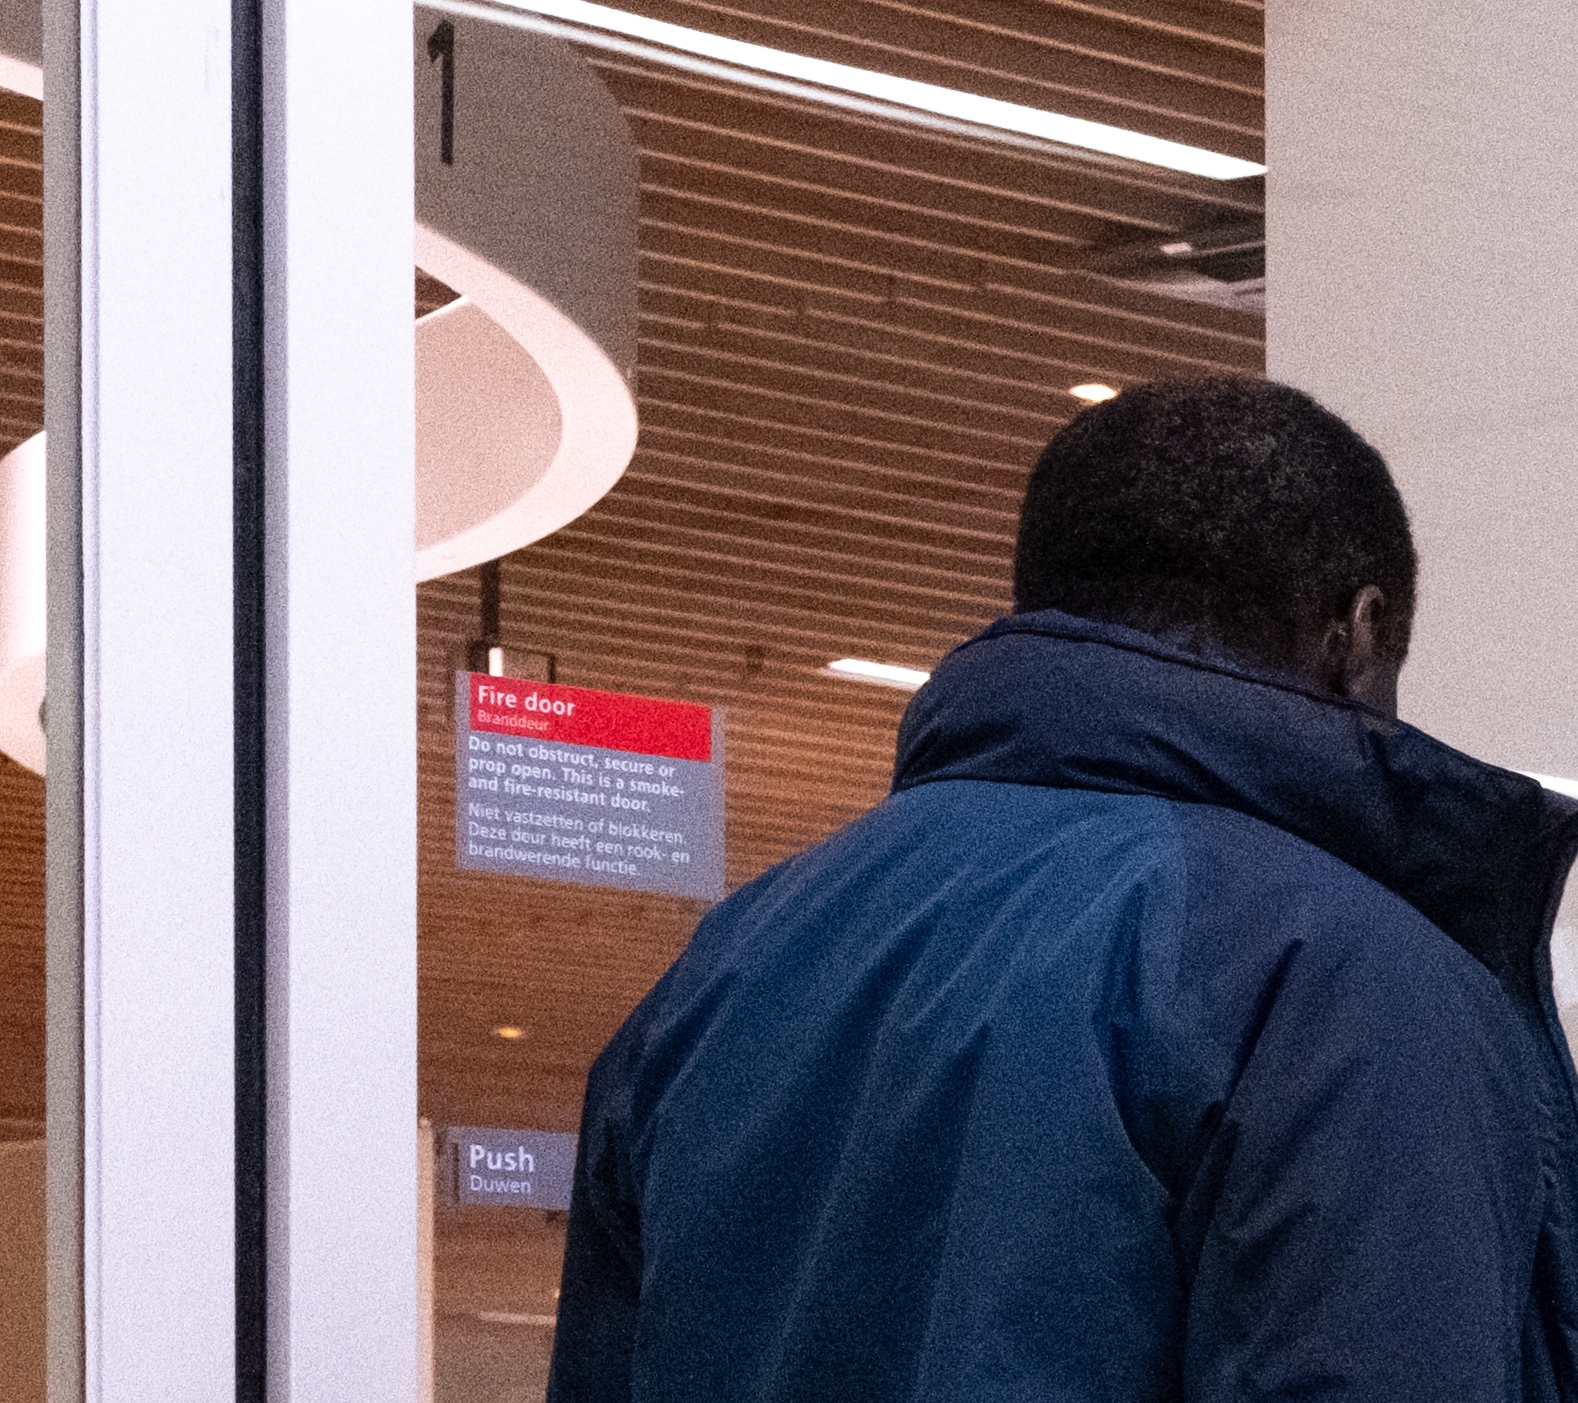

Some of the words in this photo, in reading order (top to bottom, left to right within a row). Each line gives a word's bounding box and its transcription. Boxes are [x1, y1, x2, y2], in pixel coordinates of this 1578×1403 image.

[478, 685, 517, 709] Fire
[525, 691, 576, 717] door
[477, 709, 550, 731] Branddeur
[468, 735, 491, 753] Do
[496, 741, 524, 758] not
[528, 745, 599, 769] obstruct,
[604, 757, 655, 775] secure
[659, 765, 676, 778] or
[468, 757, 506, 776] prop
[511, 763, 556, 780] open.
[562, 767, 593, 785] This
[599, 772, 611, 788] is
[616, 777, 625, 790] a
[629, 780, 685, 797] smoke-
[468, 776, 499, 792] and
[503, 777, 606, 806] fire-resistant
[611, 792, 651, 812] door.
[468, 801, 501, 820] Niet
[504, 809, 584, 831] vastzetten
[588, 818, 605, 834] of
[468, 820, 507, 841] Deze
[511, 826, 547, 845] deur
[551, 832, 592, 852] heeft
[596, 840, 623, 857] een
[671, 850, 691, 864] en
[468, 839, 580, 868] brandwerende
[469, 1143, 535, 1173] Push
[469, 1174, 532, 1195] Duwen
